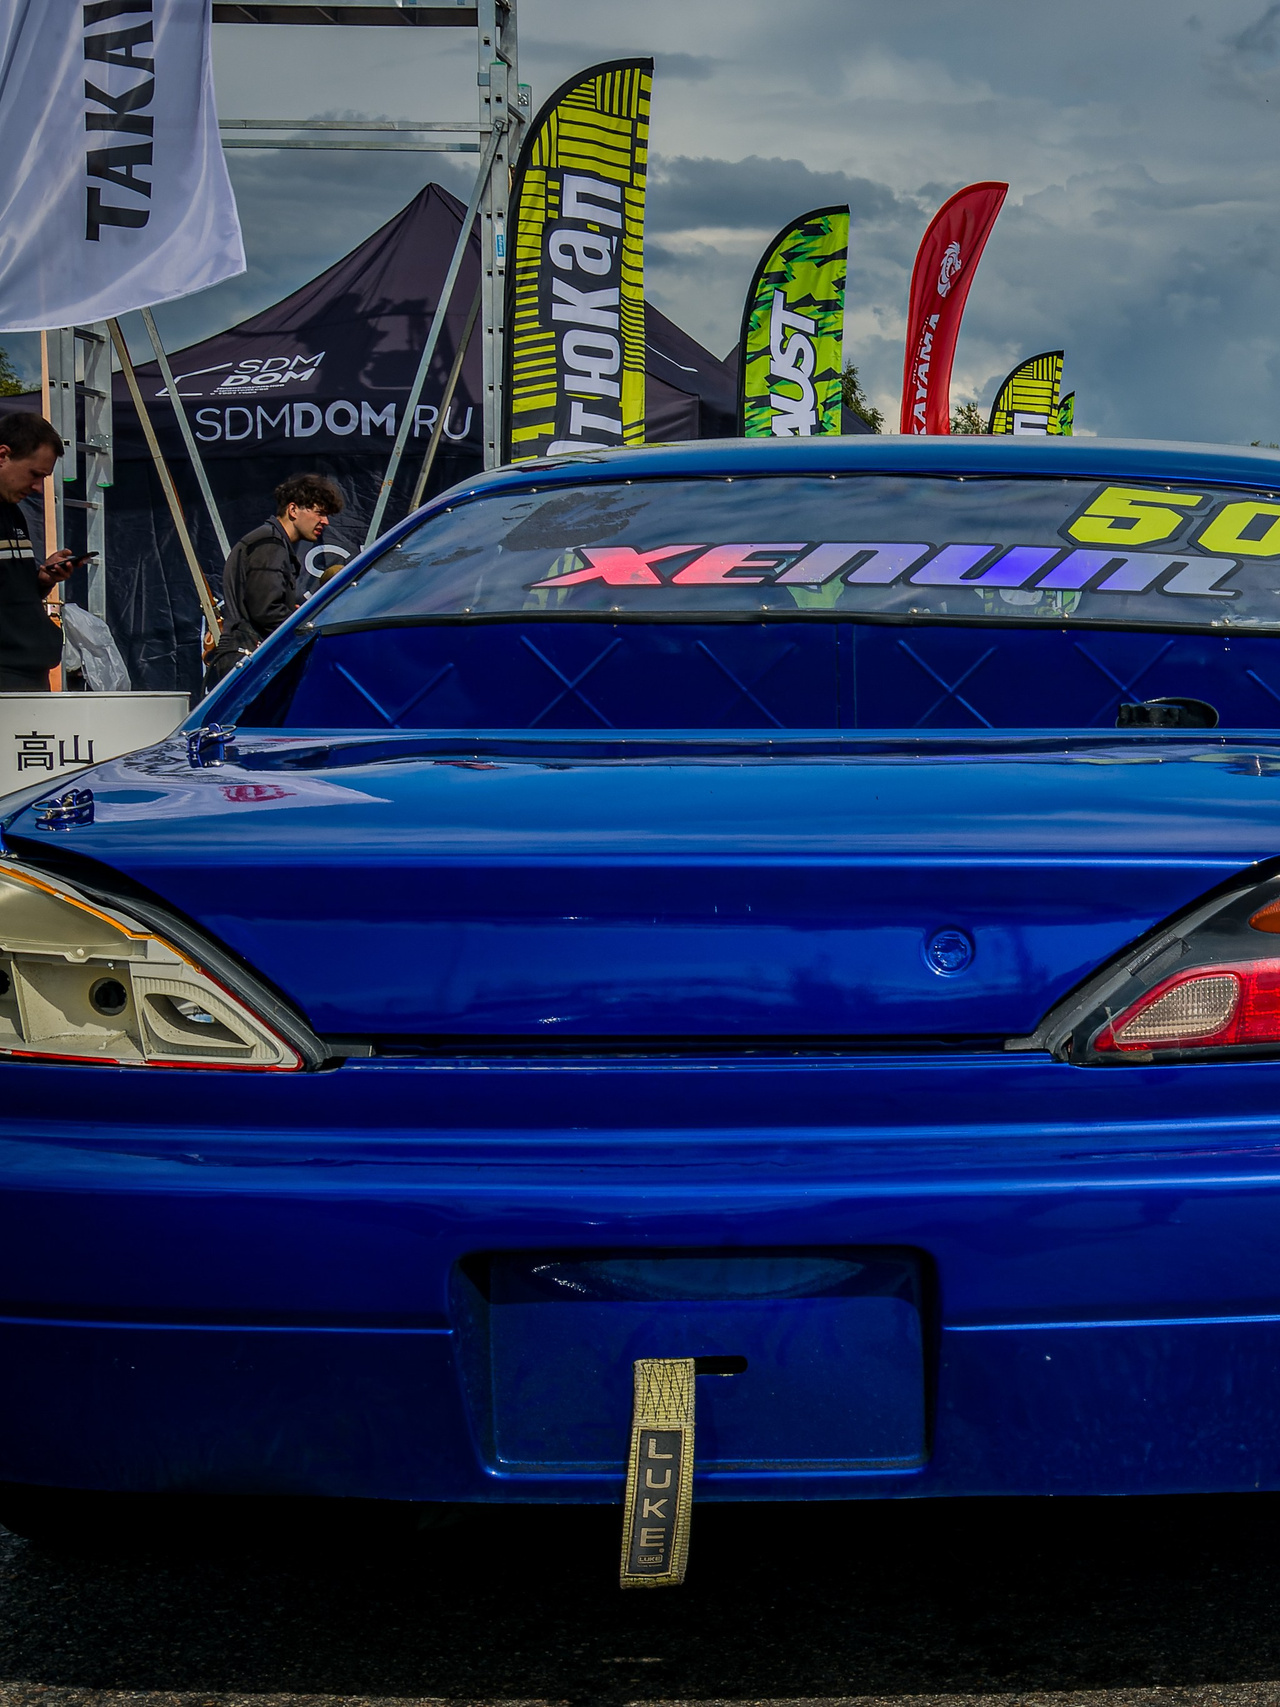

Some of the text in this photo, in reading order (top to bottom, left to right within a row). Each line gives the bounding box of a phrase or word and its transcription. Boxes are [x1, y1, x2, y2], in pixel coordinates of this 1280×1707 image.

[233, 351, 326, 374] SDM
[220, 368, 316, 387] DOM
[14, 730, 94, 771] 高山
